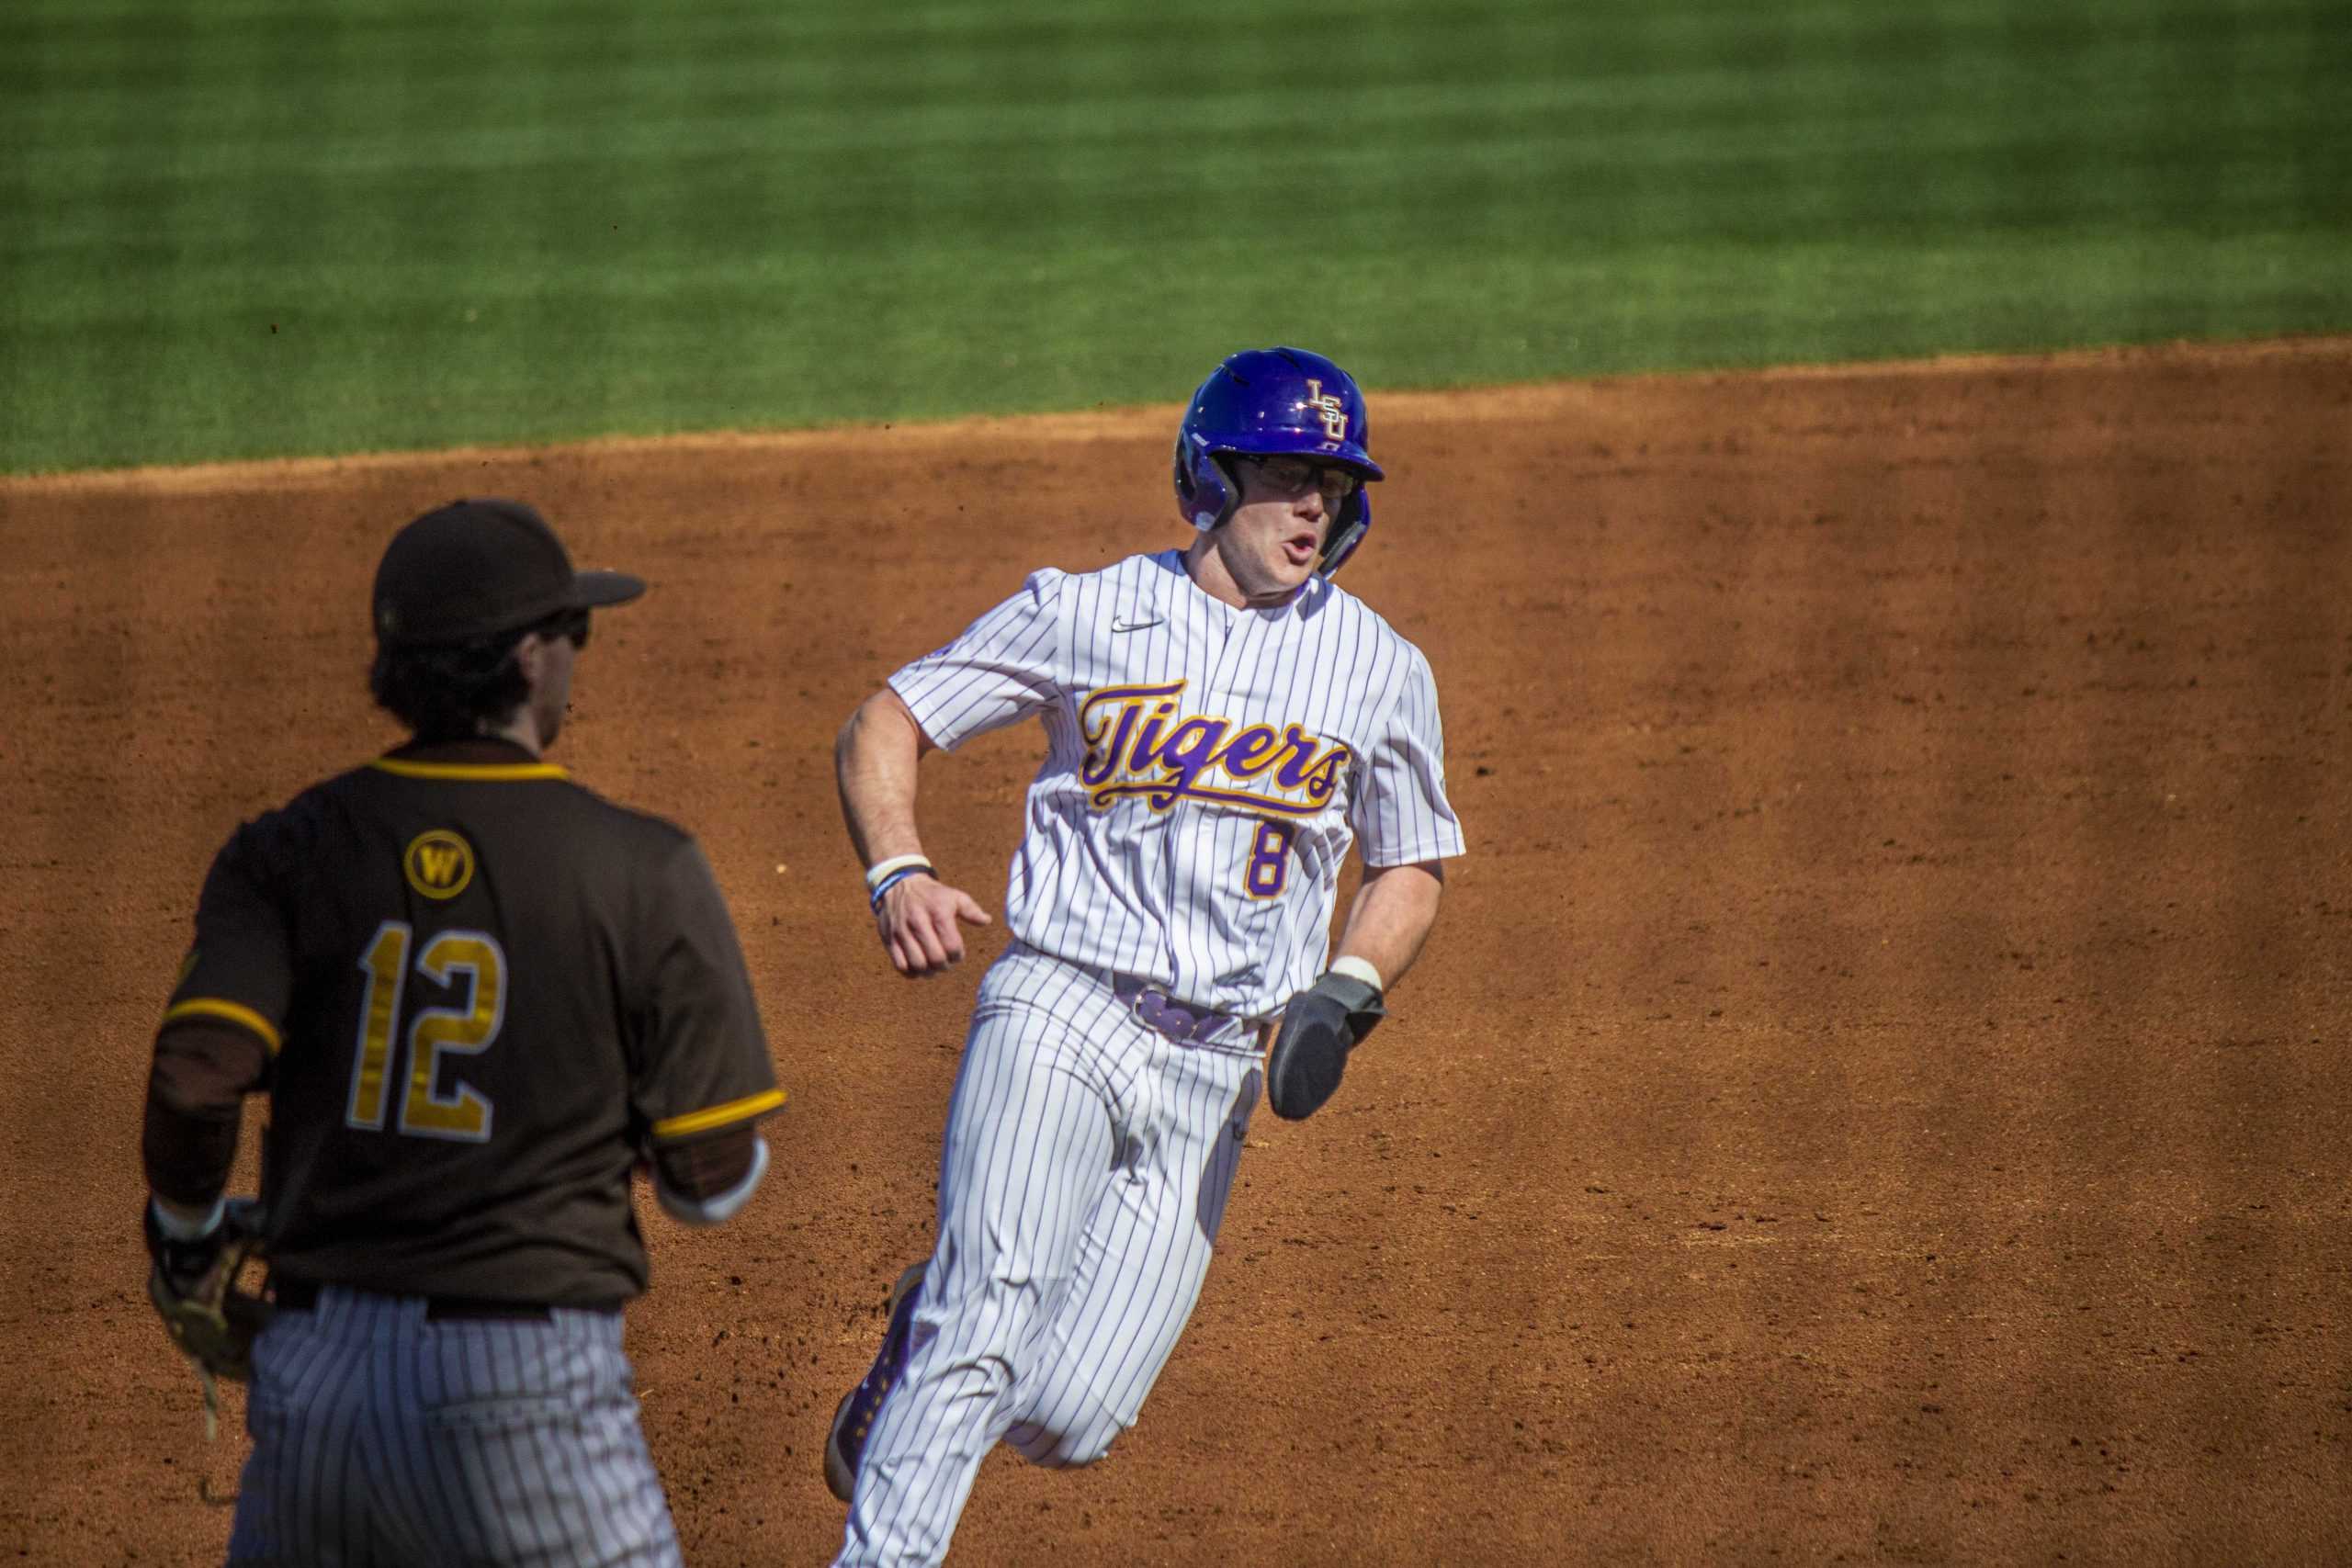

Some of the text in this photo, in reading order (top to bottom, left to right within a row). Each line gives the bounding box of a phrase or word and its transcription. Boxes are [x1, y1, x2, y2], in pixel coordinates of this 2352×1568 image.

[1306, 378, 1348, 441] LSU
[1079, 678, 1352, 818] Tigers
[417, 842, 463, 886] W
[1243, 819, 1291, 900] 8
[345, 919, 509, 1143] 12
